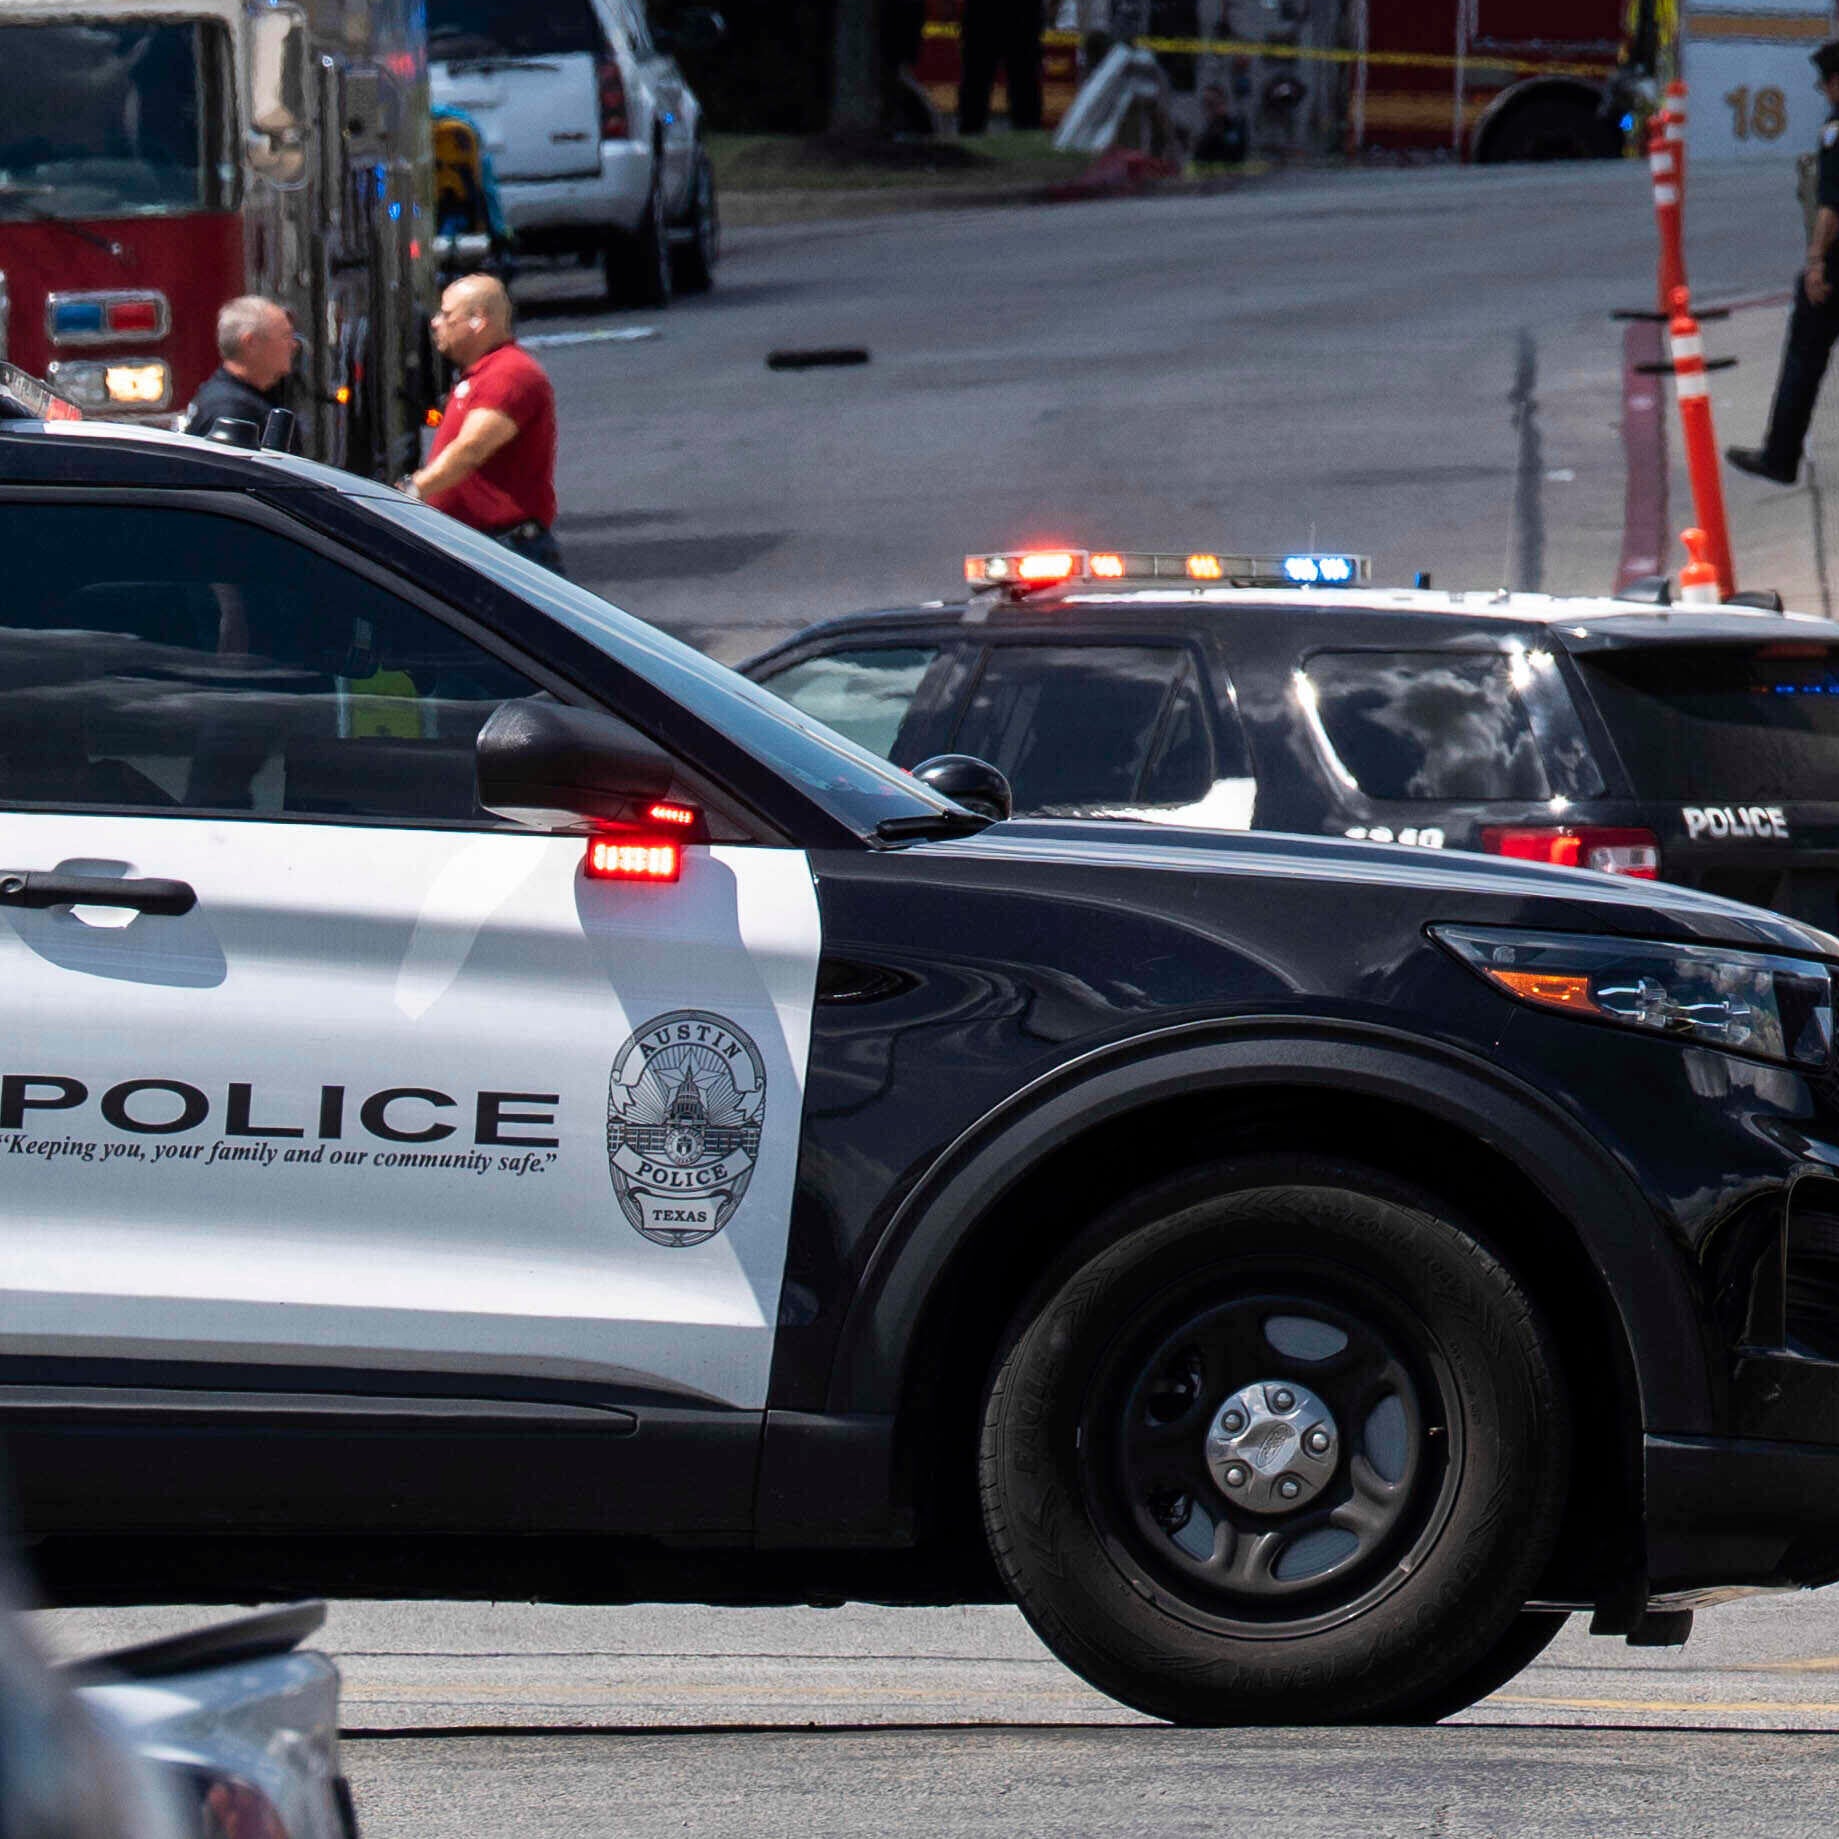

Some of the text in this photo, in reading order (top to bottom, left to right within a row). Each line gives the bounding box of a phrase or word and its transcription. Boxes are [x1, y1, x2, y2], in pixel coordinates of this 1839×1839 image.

[1723, 84, 1787, 142] 18
[1682, 806, 1790, 841] POLICE
[639, 1023, 742, 1060] AUSTIN
[0, 1074, 560, 1148] POLICE
[100, 1141, 147, 1163] you,
[148, 1141, 205, 1164] your
[204, 1139, 279, 1167] family
[283, 1143, 326, 1164] and
[328, 1150, 368, 1166] our
[372, 1148, 493, 1176] community
[635, 1160, 729, 1188] POLICE
[652, 1209, 708, 1223] TEXAS
